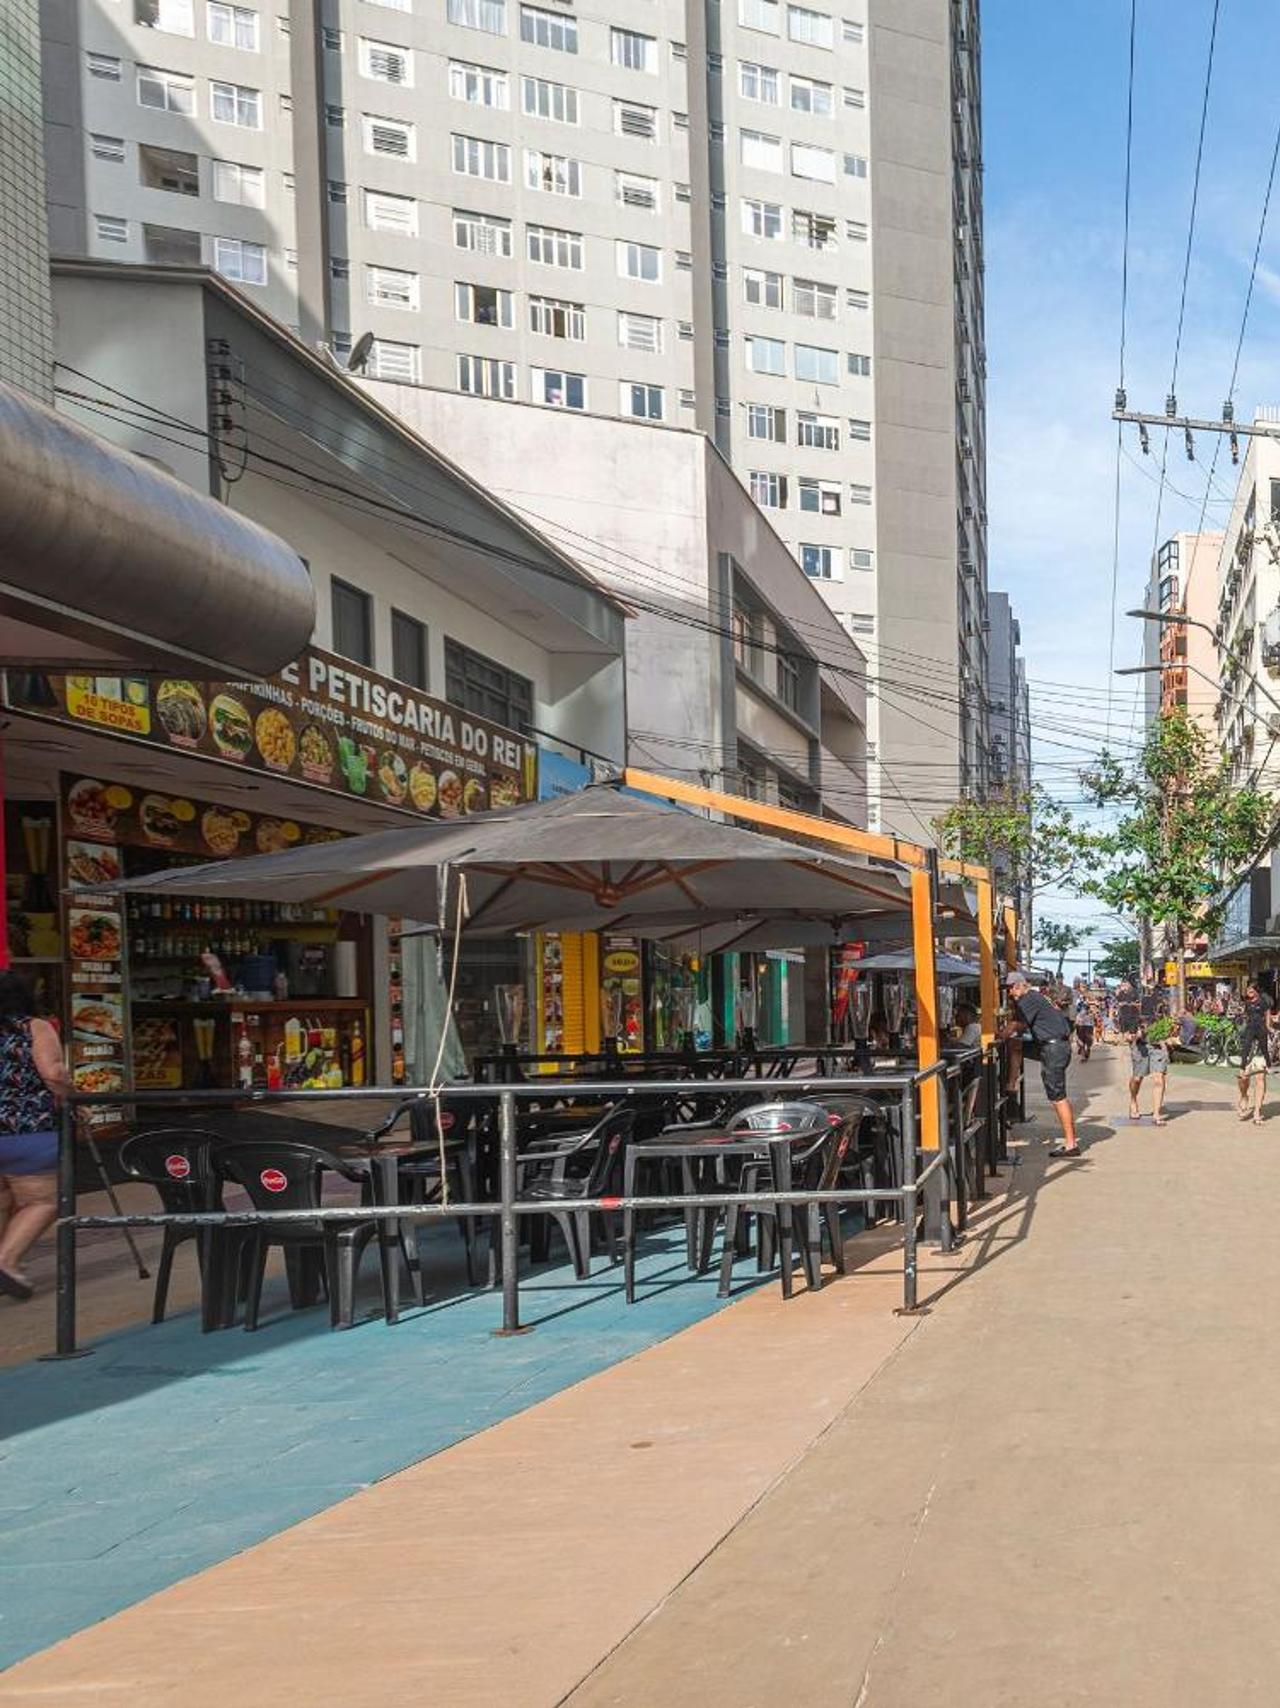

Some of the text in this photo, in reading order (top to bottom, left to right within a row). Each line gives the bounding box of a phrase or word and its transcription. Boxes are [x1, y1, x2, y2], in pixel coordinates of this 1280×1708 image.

[309, 656, 455, 746] PETISCARIA
[461, 721, 488, 756] DO
[493, 735, 521, 770] REI
